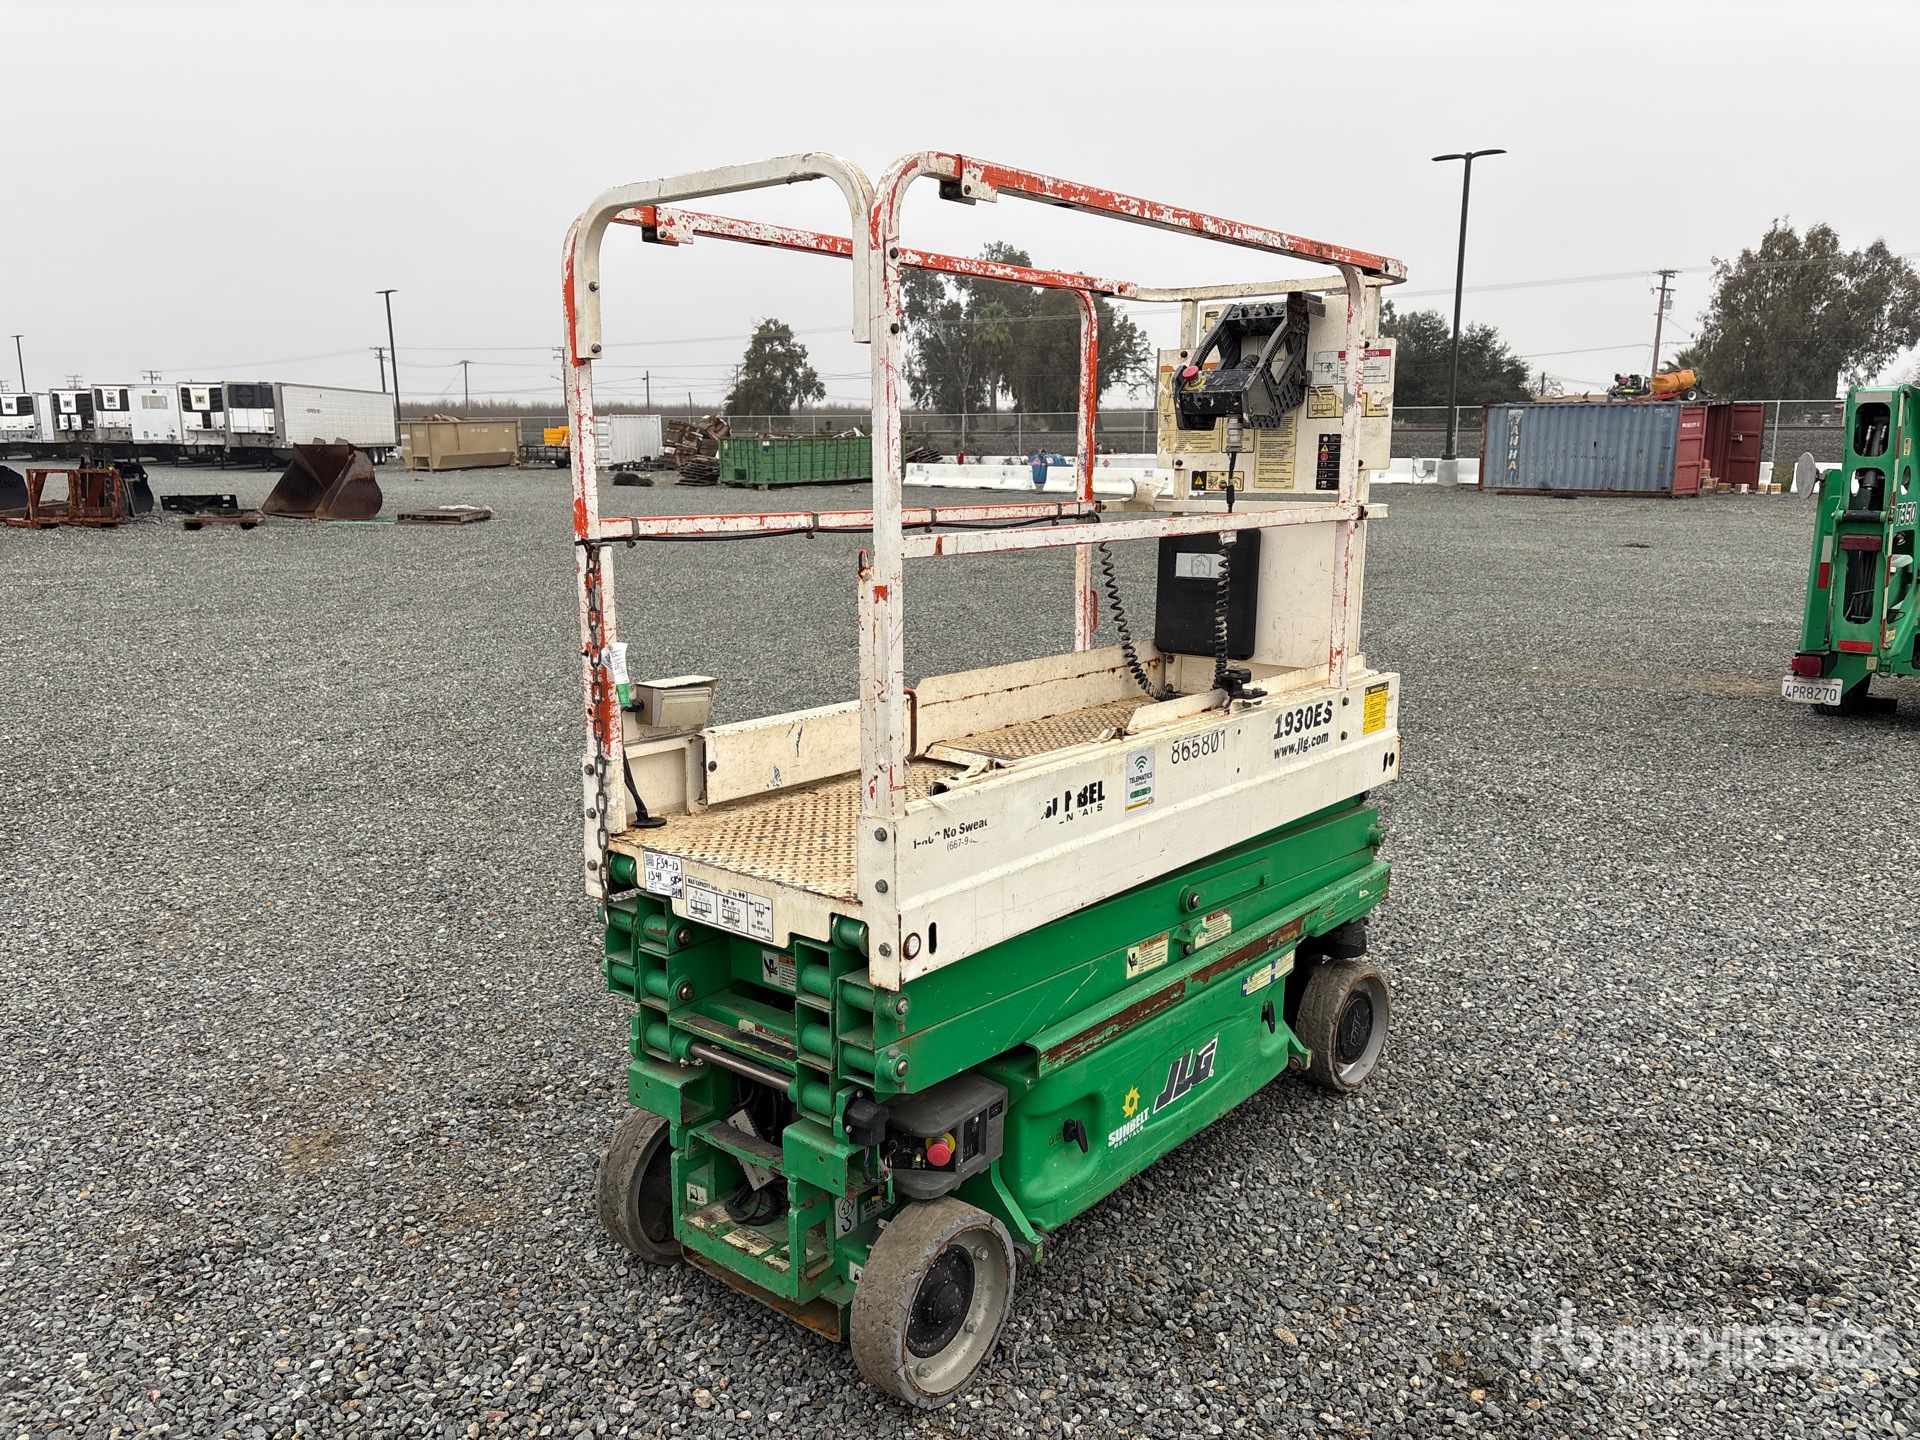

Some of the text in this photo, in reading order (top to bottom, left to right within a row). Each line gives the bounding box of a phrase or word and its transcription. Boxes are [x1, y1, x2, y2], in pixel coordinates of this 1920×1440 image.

[1896, 501, 1917, 527] T350
[1785, 685, 1837, 701] 4PR8270
[1273, 700, 1333, 740] 1930ES
[1171, 728, 1227, 765] 865801
[1273, 731, 1329, 760] www.jlg.com
[1129, 771, 1153, 785] TELEMATICS
[943, 826, 957, 840] No
[648, 870, 662, 882] 1341
[1152, 1032, 1220, 1114] JLG
[1108, 1107, 1150, 1147] SUNBELT
[1114, 1125, 1144, 1149] RENTALS
